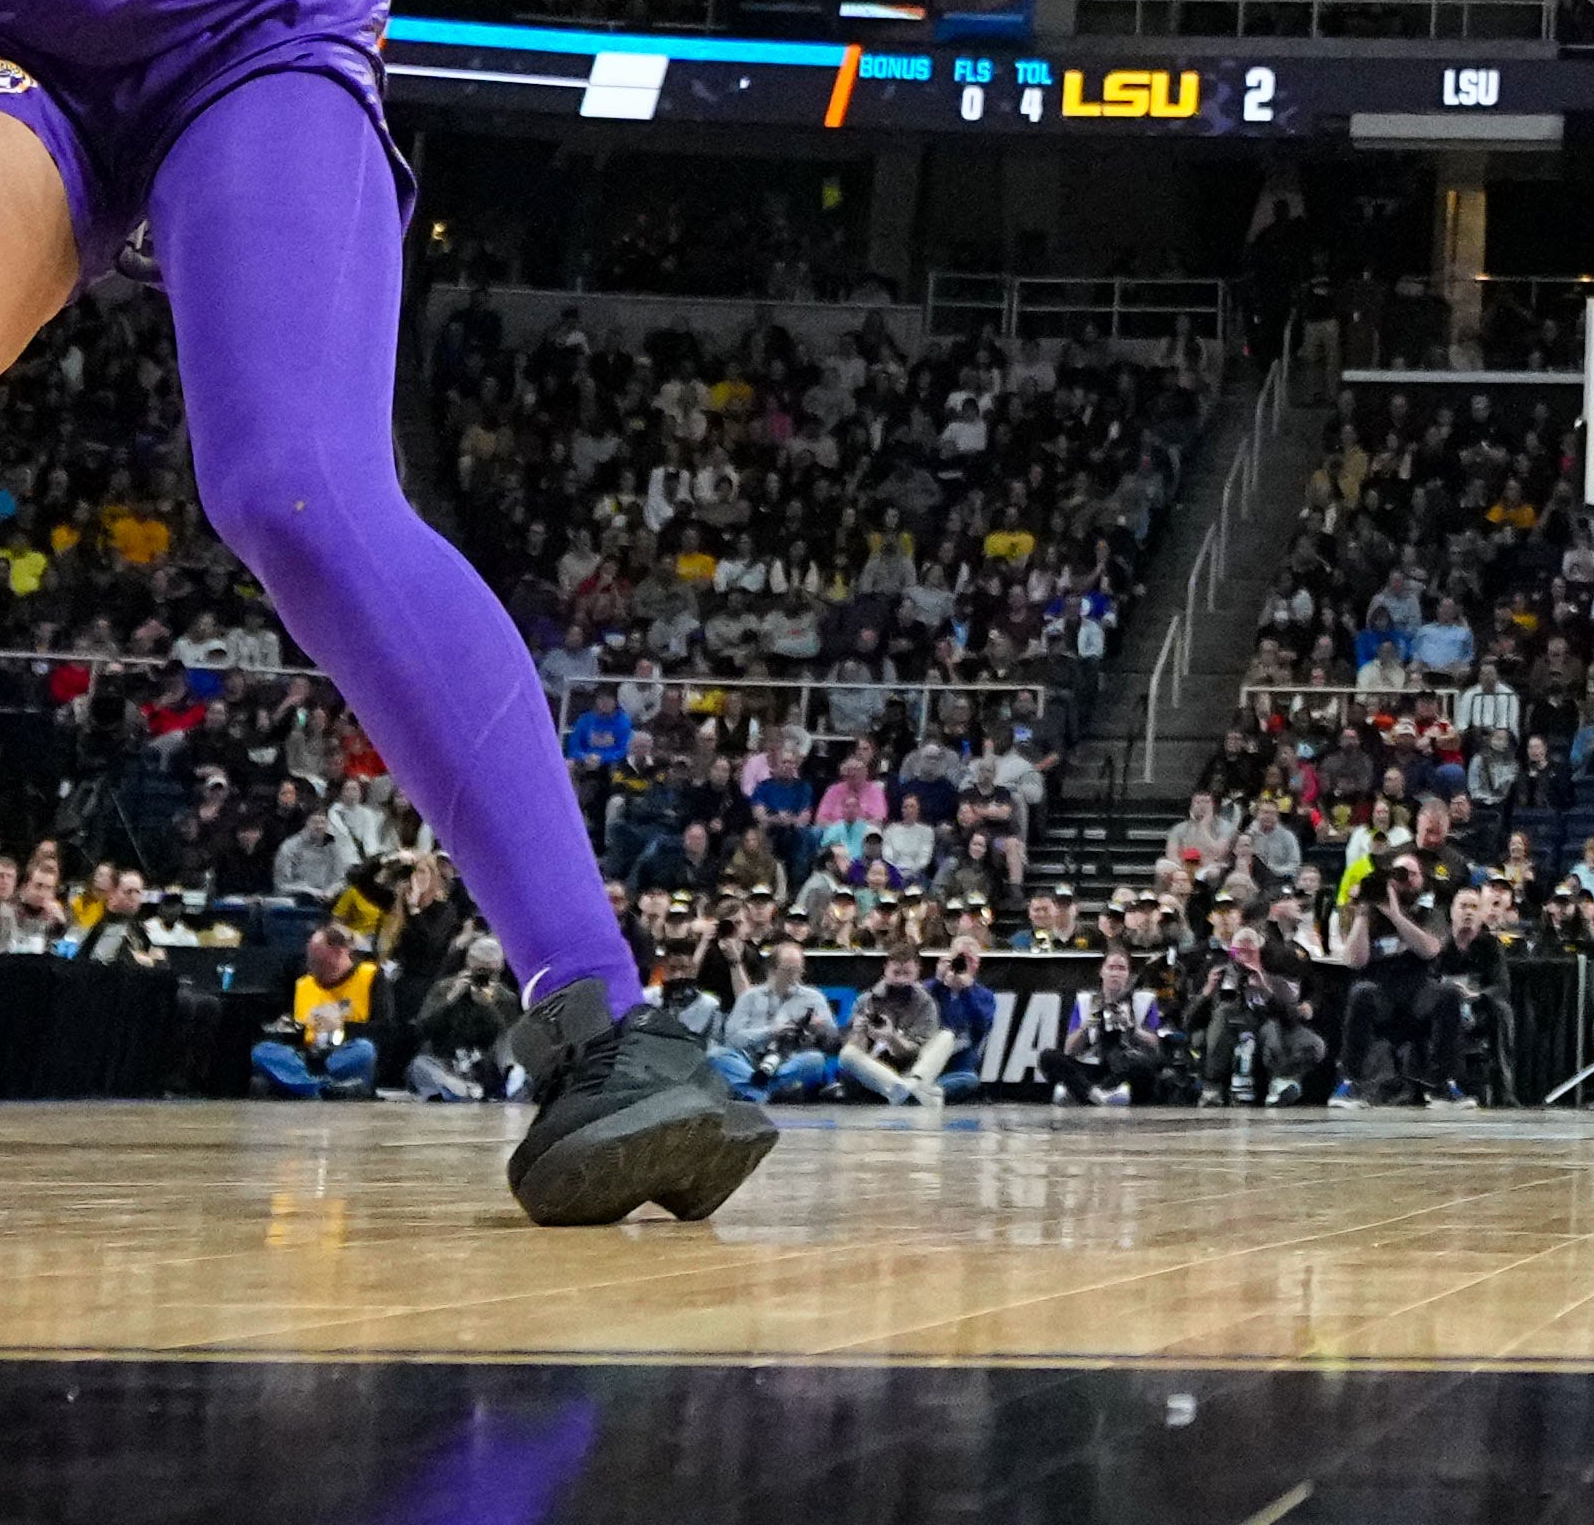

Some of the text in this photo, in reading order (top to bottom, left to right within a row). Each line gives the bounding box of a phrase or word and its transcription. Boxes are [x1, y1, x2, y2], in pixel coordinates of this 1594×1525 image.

[859, 54, 1053, 86] BONUS FLS TOL
[1442, 68, 1501, 107] LSU
[960, 84, 1044, 123] 0 4
[1062, 65, 1277, 122] LSU 2
